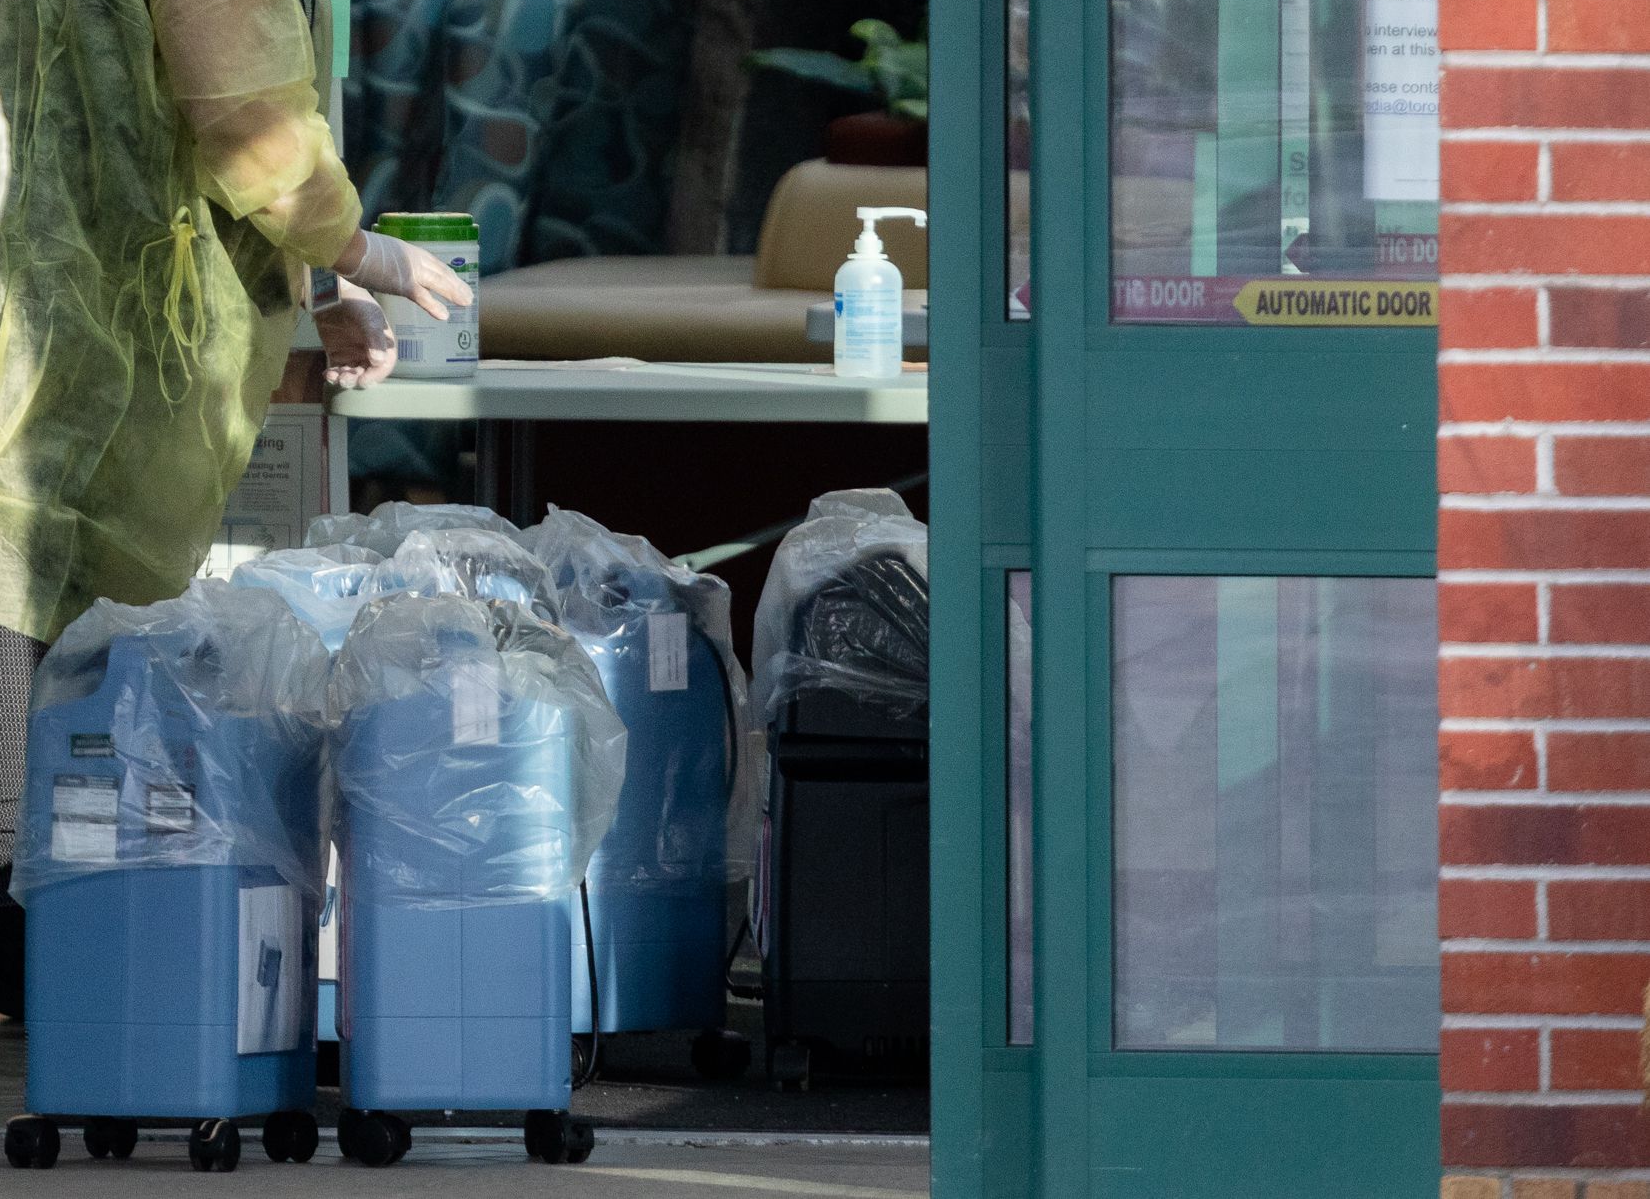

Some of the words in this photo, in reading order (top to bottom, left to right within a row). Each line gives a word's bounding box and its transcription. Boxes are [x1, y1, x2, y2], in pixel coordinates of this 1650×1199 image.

[1374, 24, 1438, 36] interview
[1392, 44, 1406, 56] at
[1410, 43, 1436, 56] this
[1366, 83, 1397, 94] ease
[1402, 82, 1438, 93] conta
[1150, 281, 1206, 307] DOOR
[1255, 290, 1371, 315] AUTOMATIC
[1376, 291, 1432, 315] DOOR
